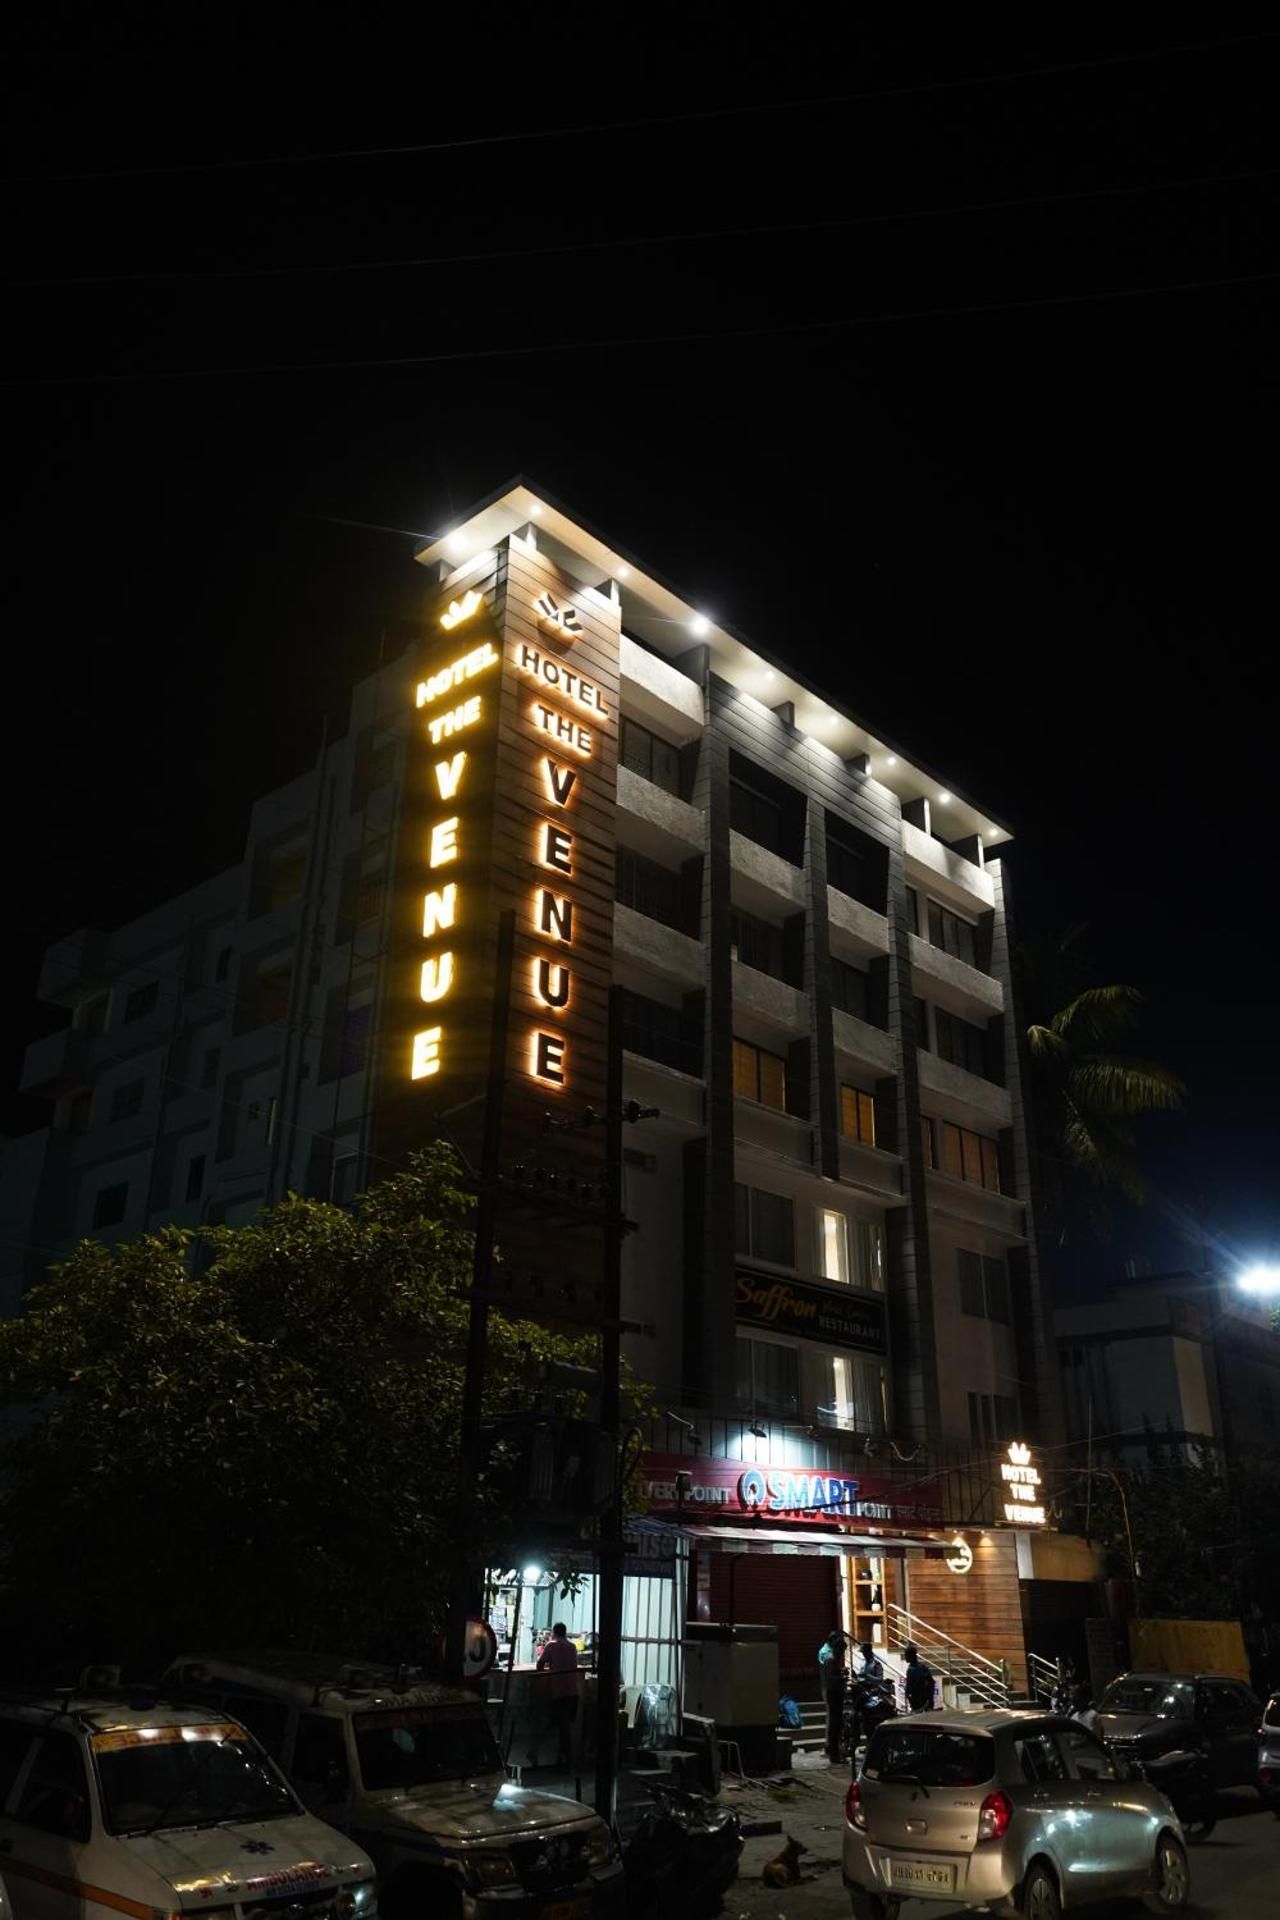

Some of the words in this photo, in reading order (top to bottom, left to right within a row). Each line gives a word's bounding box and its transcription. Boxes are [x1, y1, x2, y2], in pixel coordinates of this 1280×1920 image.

[416, 643, 498, 708] HOTEL
[520, 644, 609, 718] HOTEL
[428, 695, 482, 745] THE
[536, 704, 592, 756] THE
[411, 751, 468, 1081] VENUE
[536, 757, 577, 1085] VENUE
[735, 1276, 817, 1321] Saffron
[766, 1470, 860, 1517] SMART
